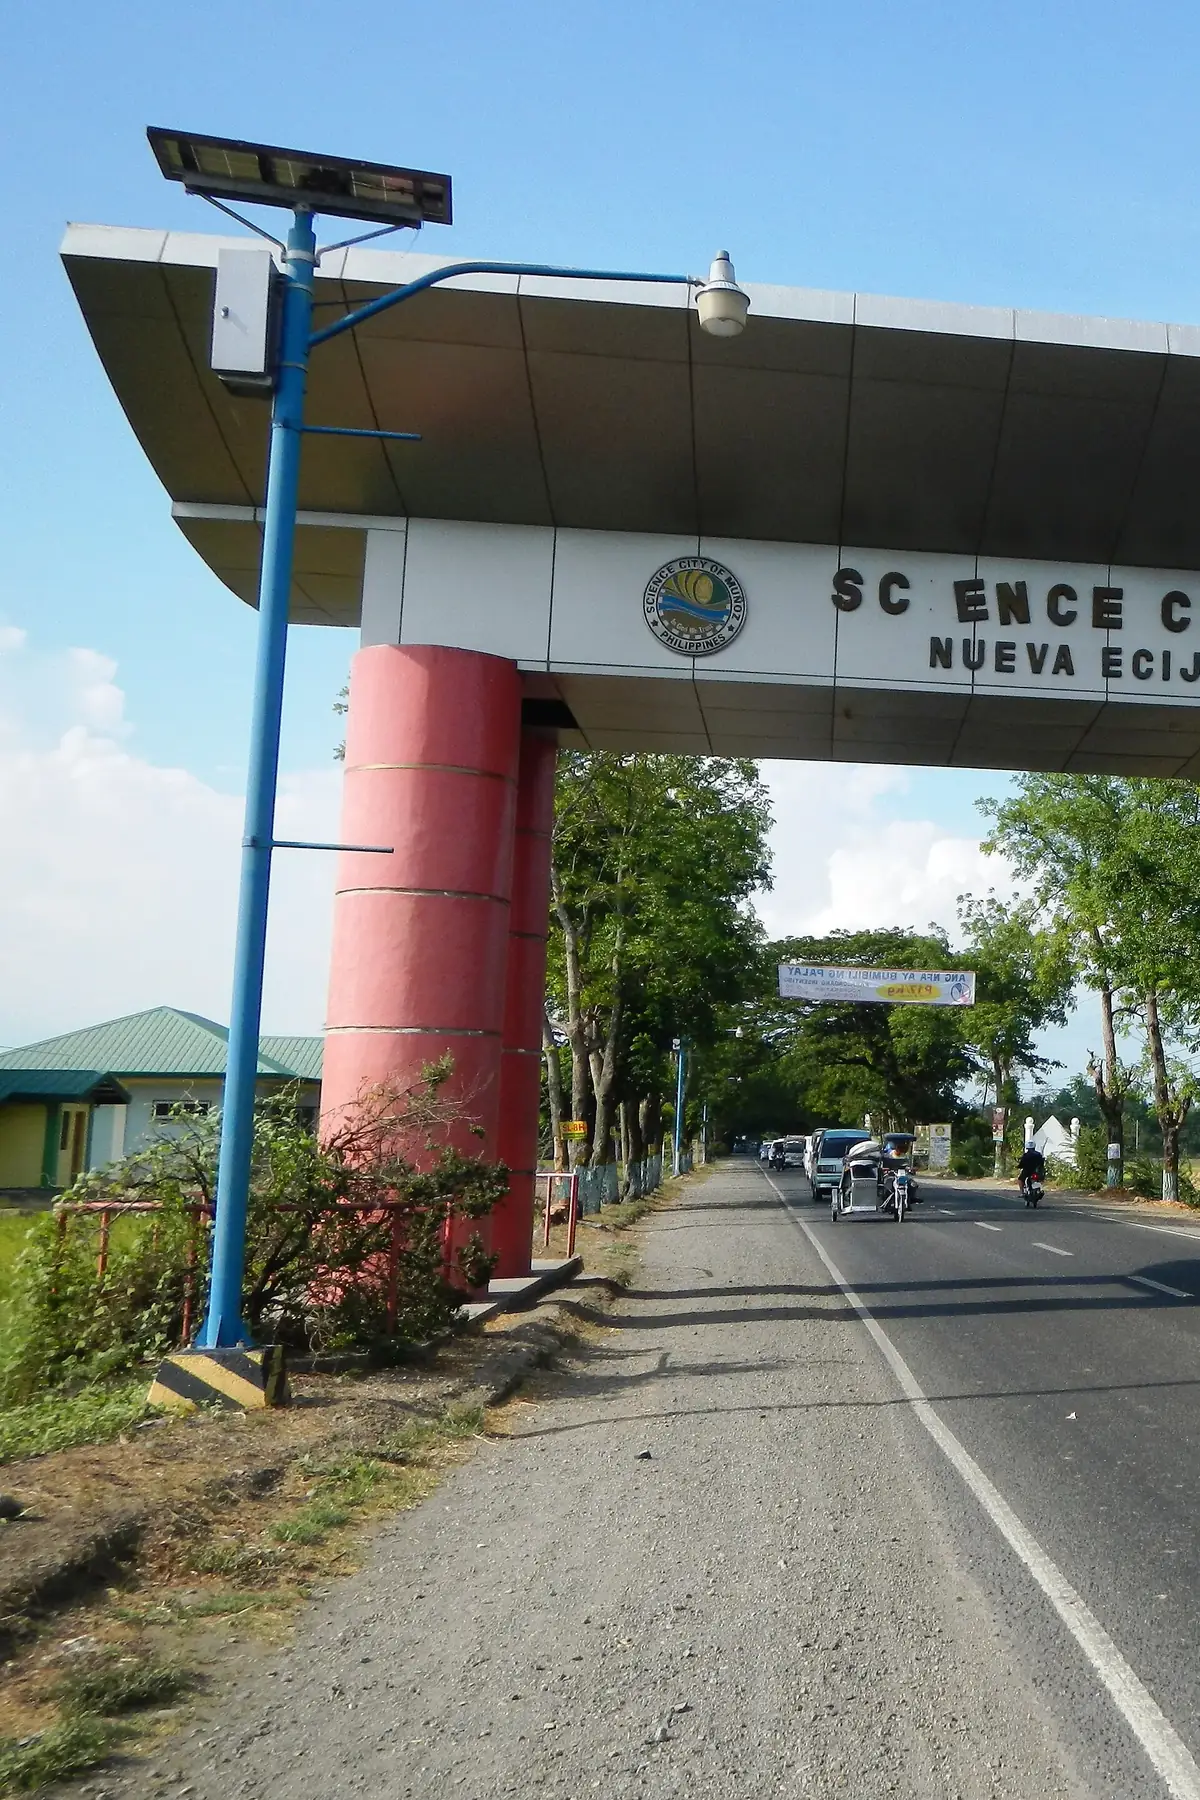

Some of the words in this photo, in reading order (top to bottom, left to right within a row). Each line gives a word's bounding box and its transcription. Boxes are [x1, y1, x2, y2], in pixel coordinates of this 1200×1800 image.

[646, 565, 676, 614] SCIENCE
[679, 559, 708, 570] CITY
[710, 564, 726, 577] OF
[660, 630, 726, 651] PHILIPPINES
[929, 636, 1075, 676] NUEVA
